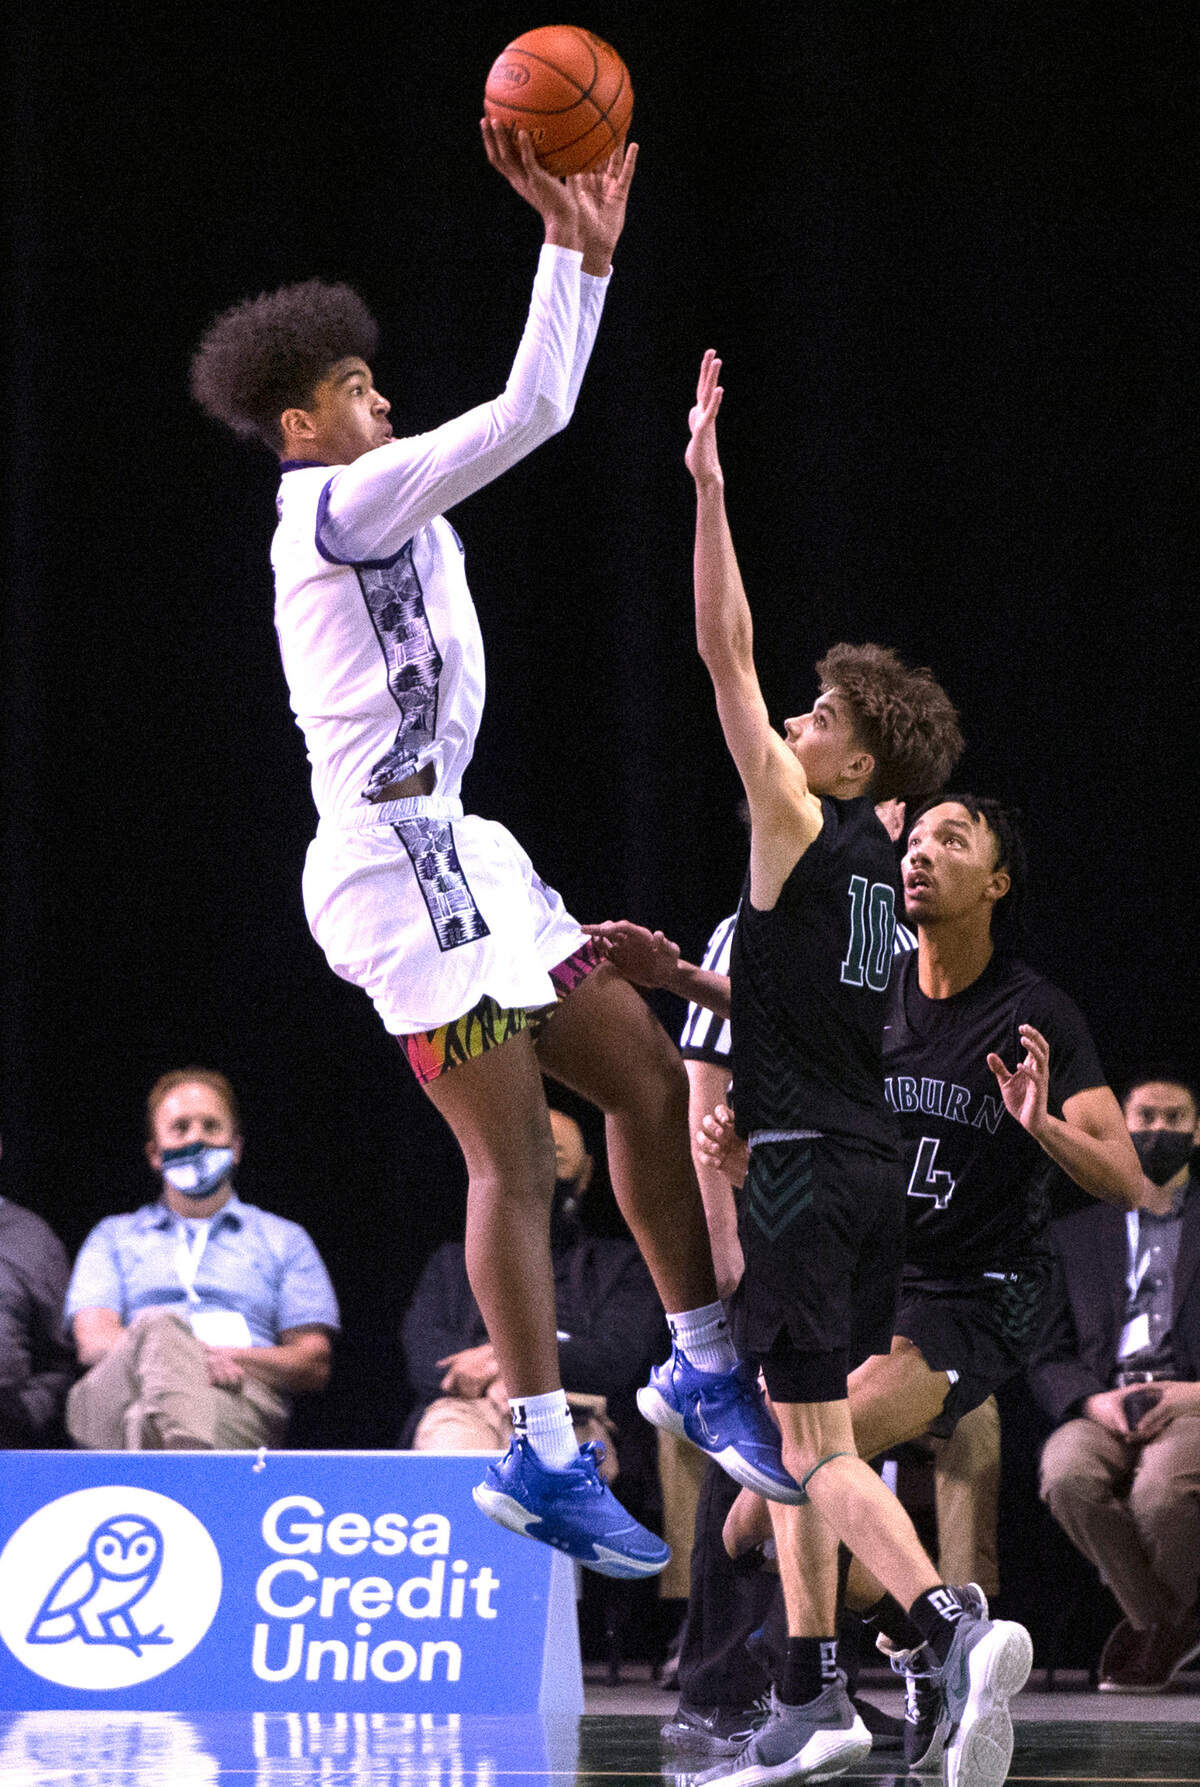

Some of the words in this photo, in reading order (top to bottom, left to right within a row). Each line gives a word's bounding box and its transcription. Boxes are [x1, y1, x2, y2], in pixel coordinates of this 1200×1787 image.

[840, 874, 897, 992] 10
[907, 1136, 956, 1209] 4
[262, 1495, 451, 1556] Gesa
[255, 1558, 500, 1619] Credit
[252, 1622, 463, 1682] Union
